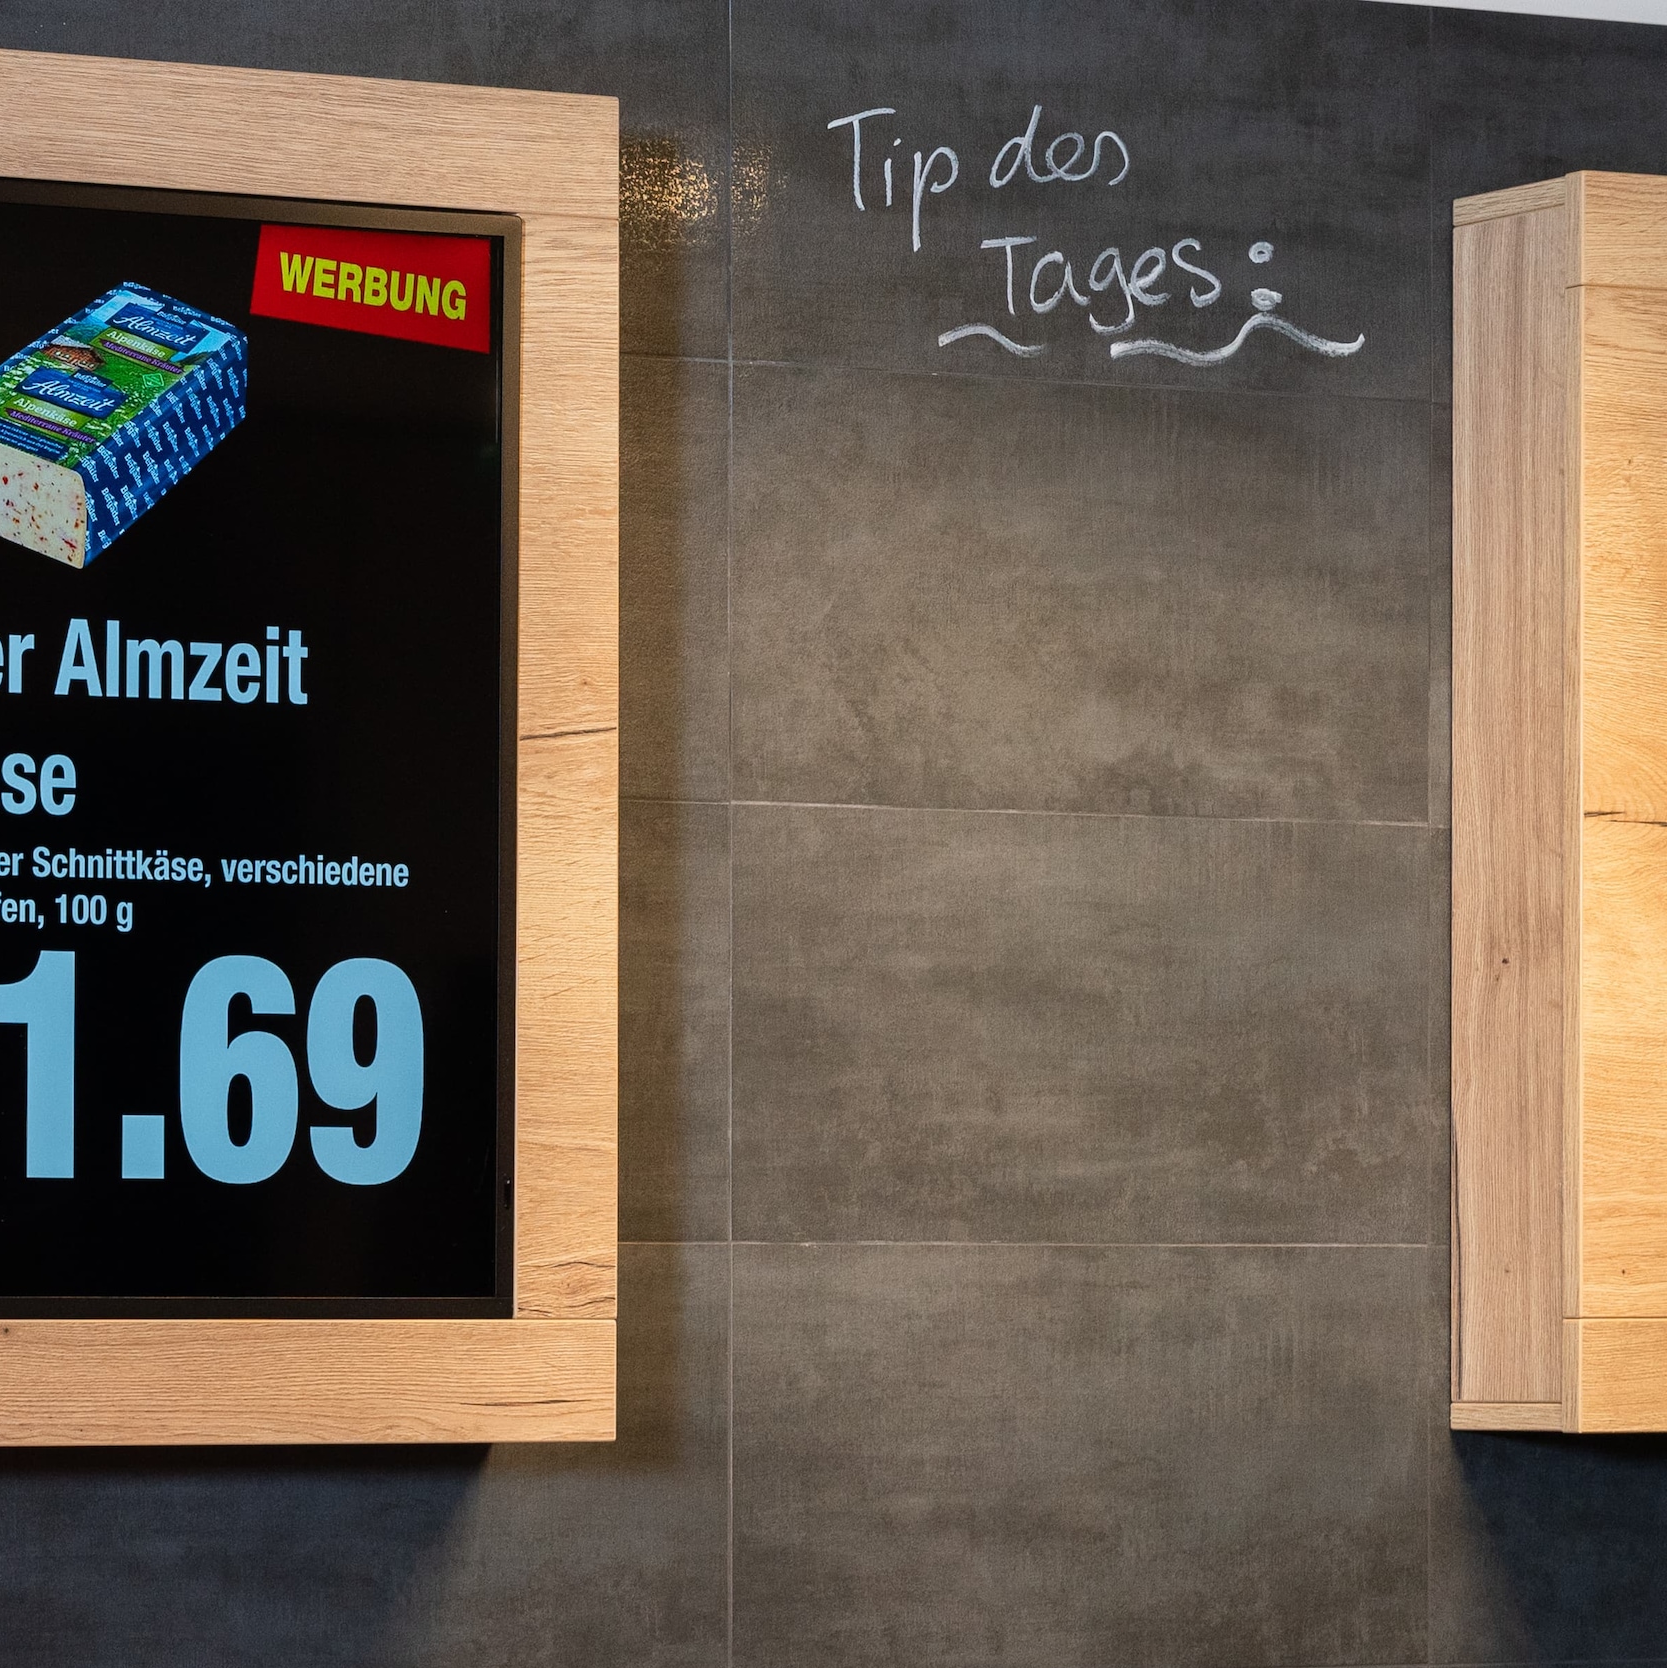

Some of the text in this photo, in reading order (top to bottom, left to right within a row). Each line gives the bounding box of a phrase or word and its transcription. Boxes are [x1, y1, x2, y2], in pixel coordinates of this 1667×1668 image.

[827, 104, 1129, 252] Tip des
[280, 251, 467, 321] WERBUNG
[113, 315, 197, 346] Almzeit
[13, 397, 78, 428] Alpenkäse
[22, 380, 116, 412] Almzeit
[55, 618, 309, 705] Almzeit
[32, 847, 212, 888] Schnittkäse,
[220, 855, 409, 888] verschiedene
[54, 893, 108, 925] 100
[116, 901, 133, 932] g
